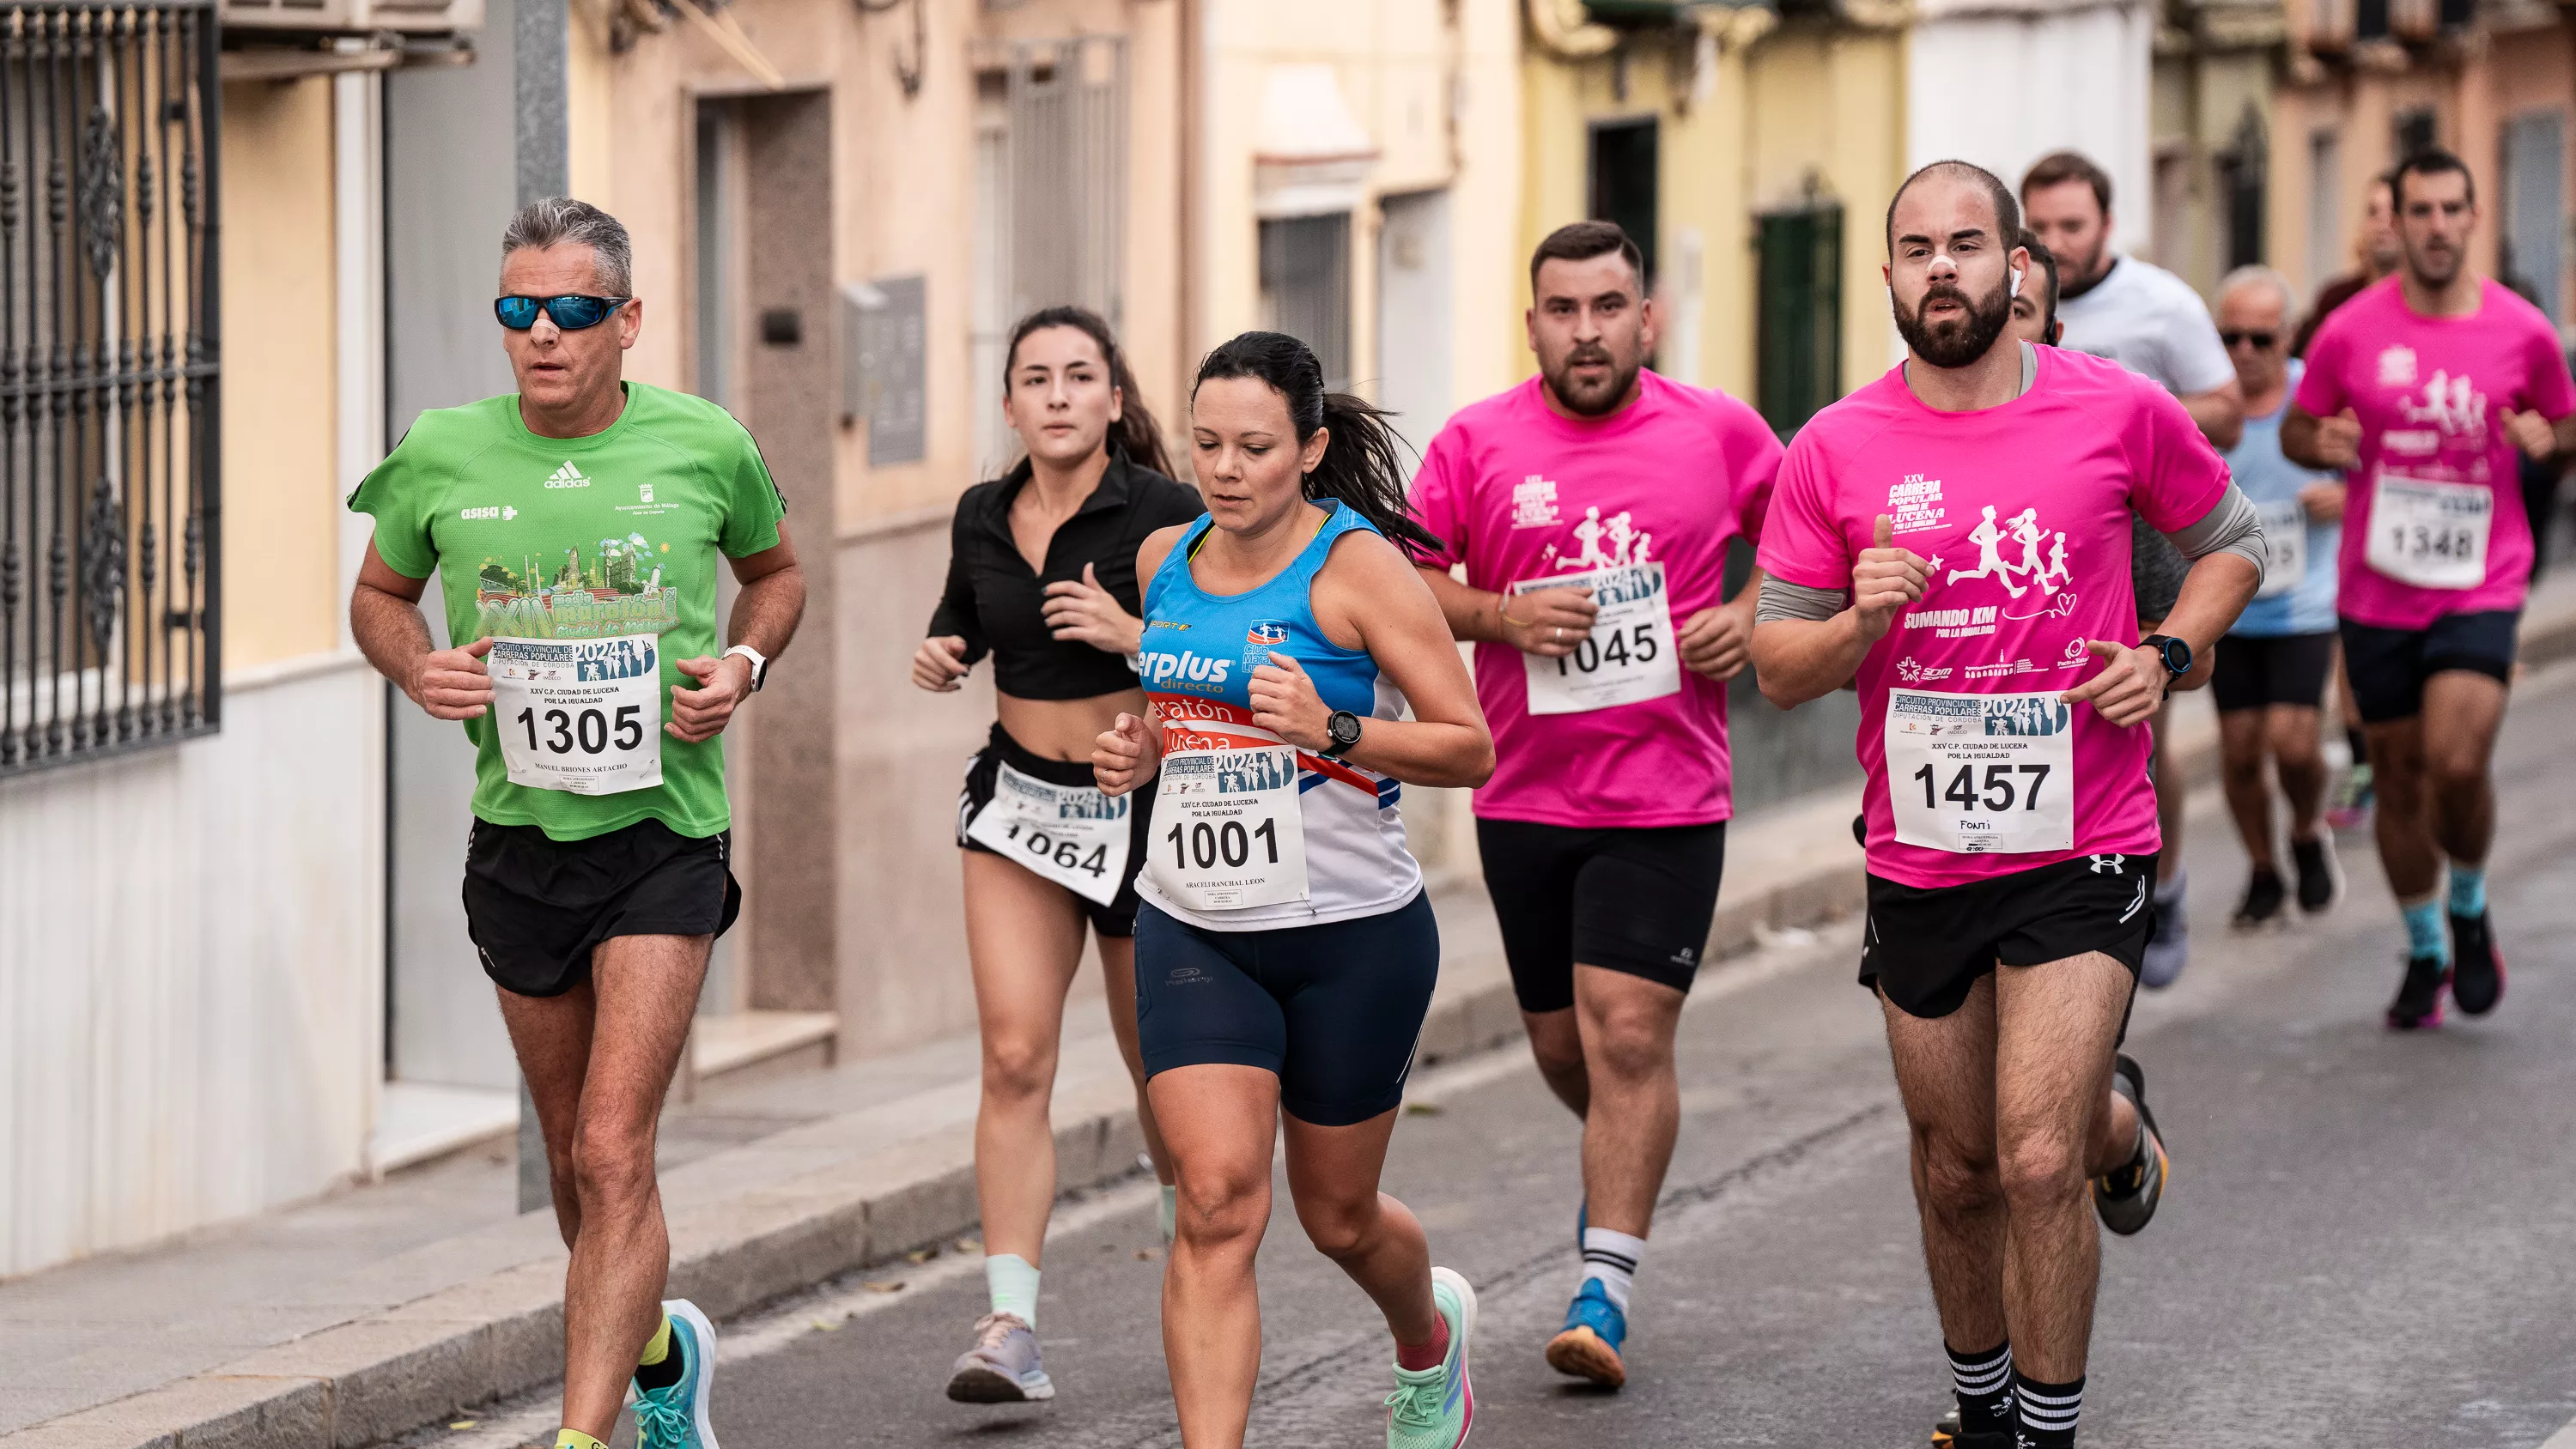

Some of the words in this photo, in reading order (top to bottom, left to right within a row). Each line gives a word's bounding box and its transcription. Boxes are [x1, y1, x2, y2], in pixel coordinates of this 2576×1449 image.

[544, 478, 590, 489] adidas
[1904, 473, 1924, 484] XXV
[1889, 480, 1941, 498] CARRERA
[1887, 493, 1943, 506] POPULAR
[461, 506, 499, 520] asisa
[1888, 508, 1945, 524] LUCENA
[1904, 609, 1970, 629] SUMANDO
[1971, 606, 1997, 625] KM
[1935, 628, 1950, 638] POR
[1950, 628, 1960, 638] LA
[1960, 625, 1996, 638] IGUALDAD
[493, 642, 520, 651] CIRCUITO
[522, 644, 562, 653] PROVINCIAL
[574, 642, 622, 662] 2024
[1244, 644, 1269, 656] Club
[493, 650, 529, 659] CARRERAS
[531, 652, 574, 661] POPULARES
[1242, 653, 1274, 665] Mara
[1161, 678, 1224, 693] directo
[1896, 694, 1926, 703] CIRCUITO
[1928, 697, 1970, 707] PROVINCIAL
[1894, 703, 1933, 713] CARRERAS
[1935, 706, 1982, 716] POPULARES
[1983, 699, 2032, 717] 2024
[518, 705, 643, 755] 1305
[535, 762, 561, 772] MANUEL
[592, 763, 628, 772] ARTACHO
[1180, 757, 1206, 766] PROVINCIAL
[1216, 753, 1259, 773] 2024
[1183, 764, 1215, 773] POPULARES
[1915, 763, 2050, 812] 1457
[1168, 817, 1279, 870] 1001
[1006, 824, 1108, 878] 1064
[1212, 879, 1244, 888] RANCHAL
